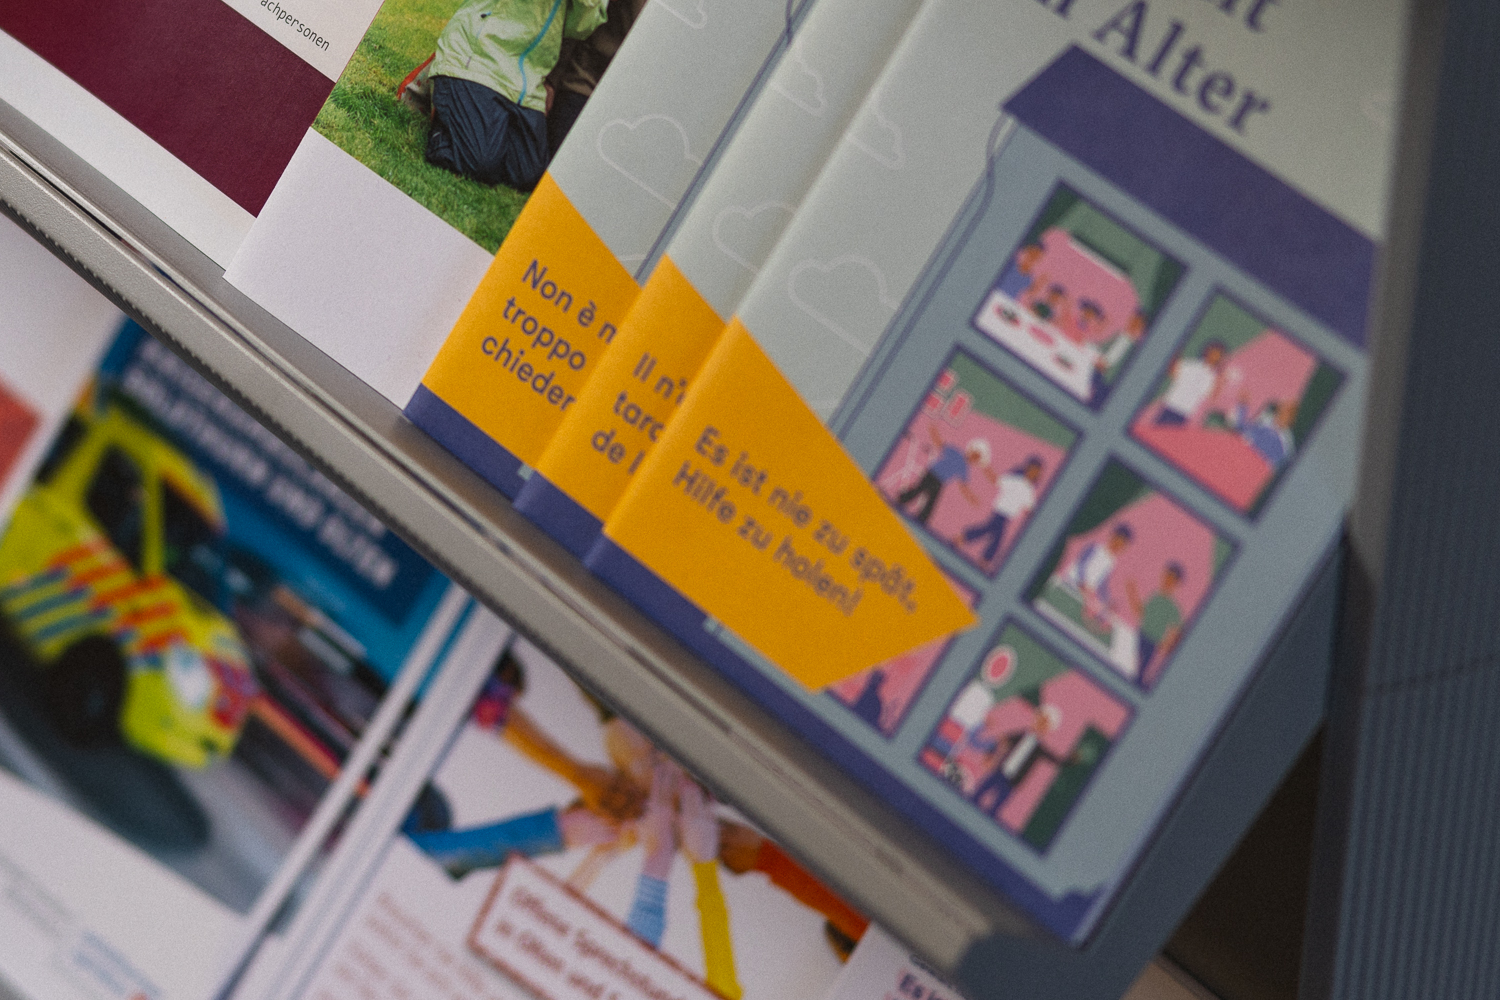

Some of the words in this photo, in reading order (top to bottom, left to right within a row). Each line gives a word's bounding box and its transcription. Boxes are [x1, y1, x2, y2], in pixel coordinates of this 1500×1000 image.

[521, 259, 574, 314] Non
[577, 300, 598, 328] è
[502, 296, 587, 371] troppo
[481, 335, 577, 412] chieder
[591, 428, 626, 465] de
[672, 460, 737, 525] Hilfe
[736, 515, 775, 552] zu
[694, 425, 730, 468] Es
[730, 450, 769, 496] ist
[767, 486, 814, 529] nie
[812, 519, 851, 556] zu
